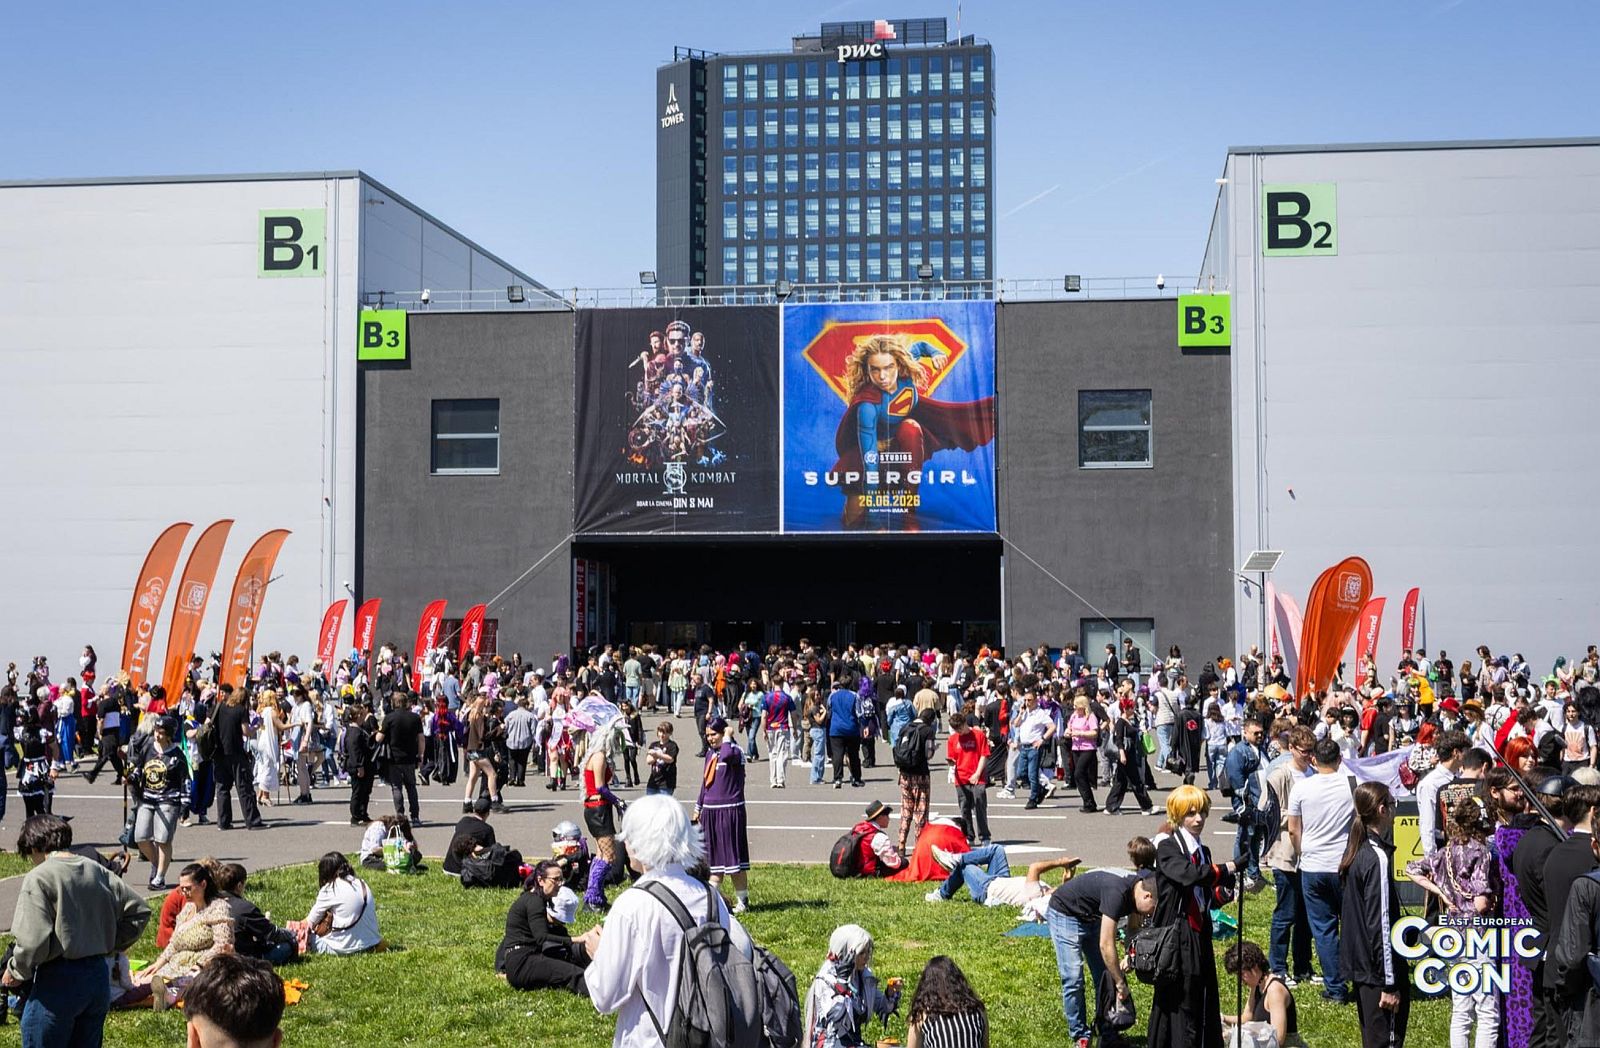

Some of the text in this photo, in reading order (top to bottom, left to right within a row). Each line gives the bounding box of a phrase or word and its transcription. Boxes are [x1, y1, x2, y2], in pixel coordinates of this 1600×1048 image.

[837, 42, 882, 63] pwc
[661, 112, 685, 129] TOWER
[665, 103, 680, 116] ANA
[1267, 192, 1333, 249] B2
[264, 217, 319, 270] B1
[1185, 306, 1225, 334] B3
[363, 322, 400, 348] B3
[880, 453, 913, 463] STUDIOS
[616, 472, 660, 484] MORTAL
[691, 472, 737, 484] KOMBAT
[804, 469, 977, 486] SUPERGIRL
[673, 497, 688, 508] DIN
[697, 497, 714, 508] MAI
[859, 494, 921, 507] 26.06.2026
[130, 618, 152, 673] ING
[232, 616, 254, 667] ING
[324, 616, 339, 657] Kaufland
[361, 615, 374, 656] aufland
[1368, 615, 1378, 653] aufland
